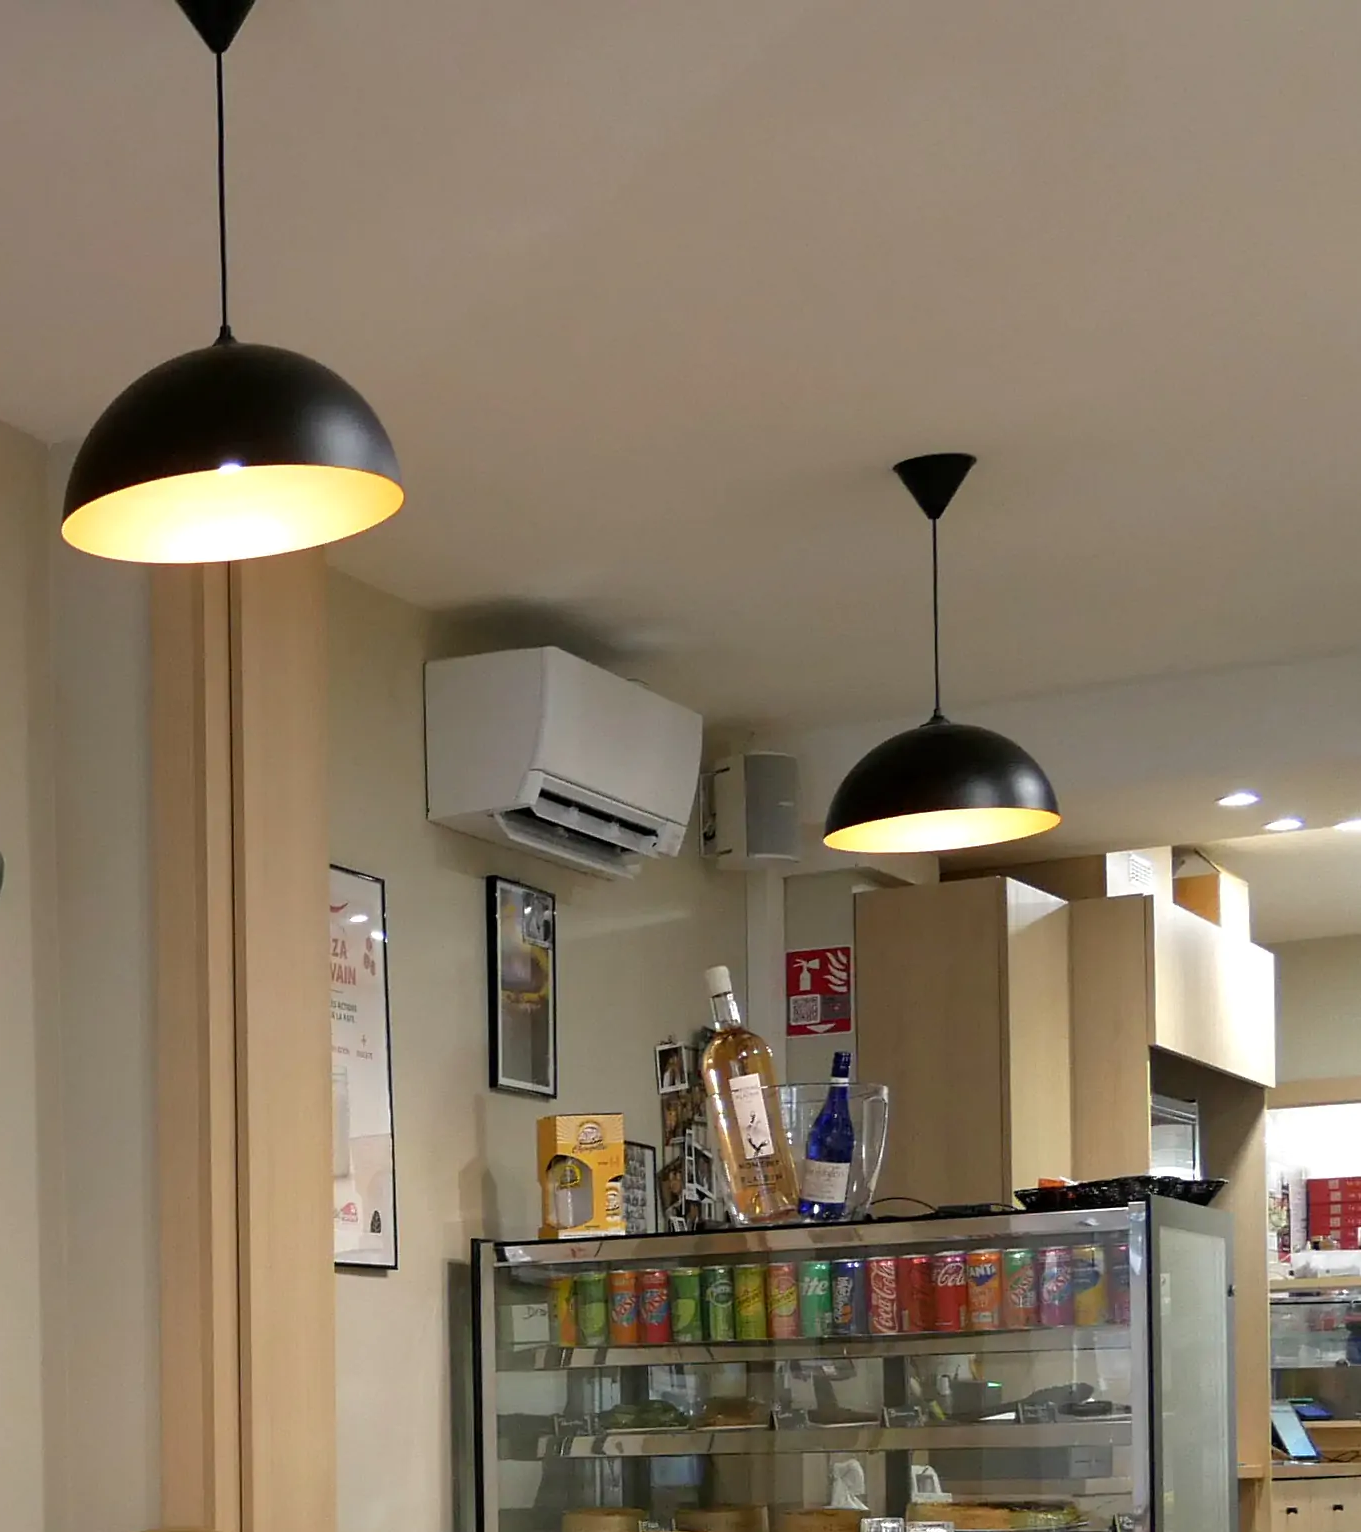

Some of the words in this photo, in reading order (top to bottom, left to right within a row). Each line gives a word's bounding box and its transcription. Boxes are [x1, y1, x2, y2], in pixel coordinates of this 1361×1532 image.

[331, 938, 348, 960] ZA
[330, 961, 357, 986] VAIN
[802, 1276, 829, 1297] ite
